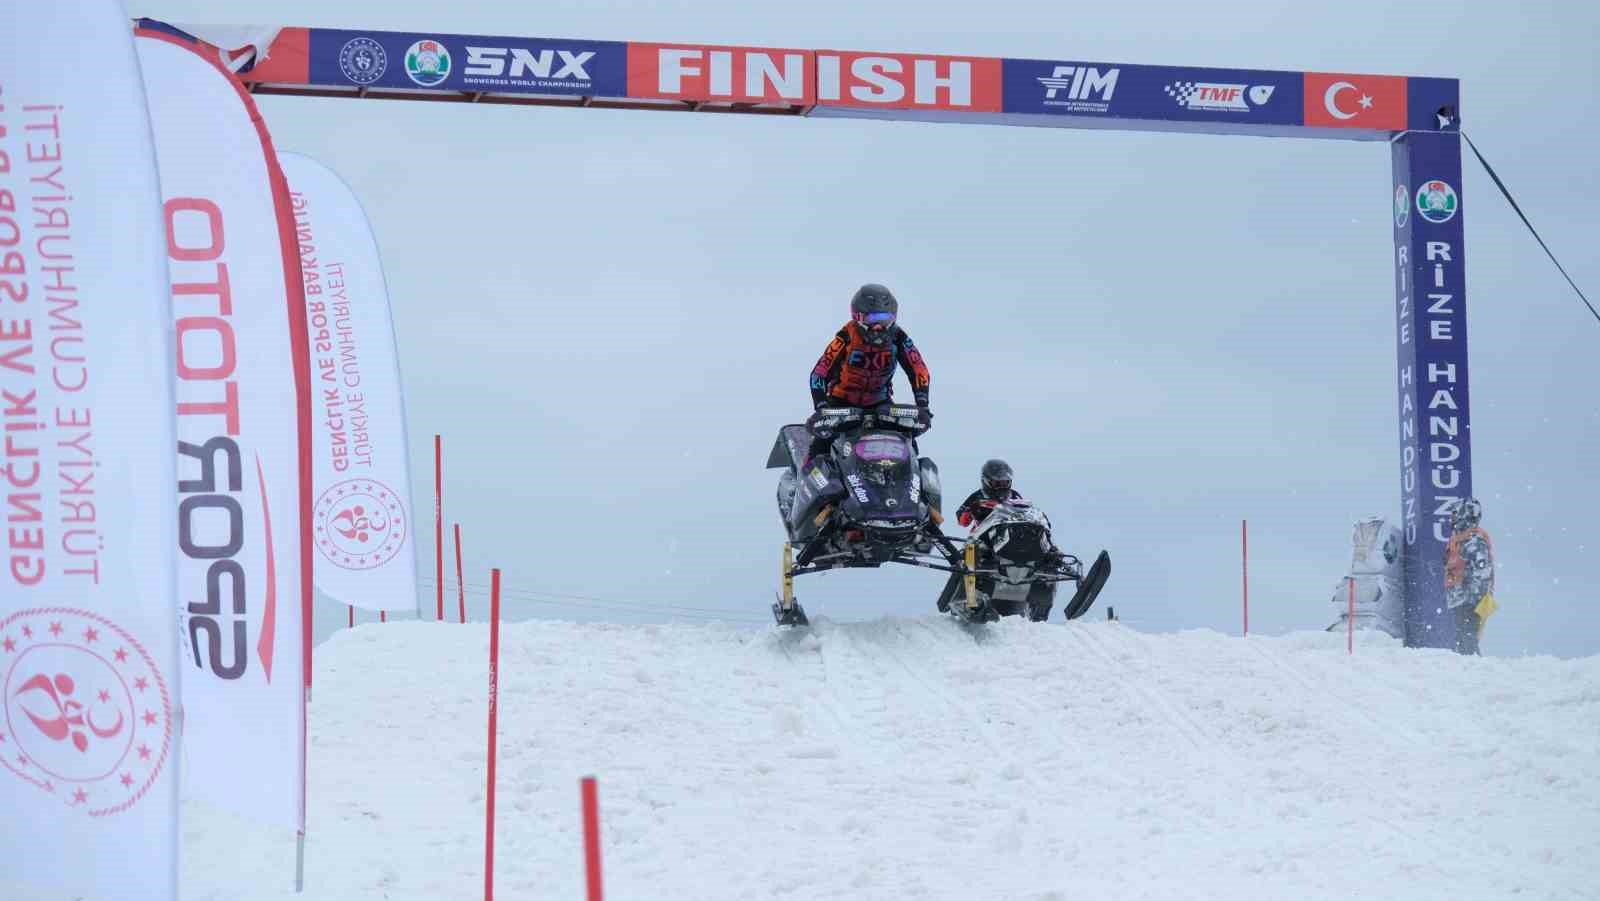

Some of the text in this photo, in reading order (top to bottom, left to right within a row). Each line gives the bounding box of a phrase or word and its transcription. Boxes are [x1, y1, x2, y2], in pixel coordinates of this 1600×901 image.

[464, 46, 597, 80] SNX
[658, 48, 972, 107] FINISH
[1036, 65, 1121, 101] FIM
[1199, 87, 1241, 103] TMF
[1425, 241, 1454, 340] RİZE
